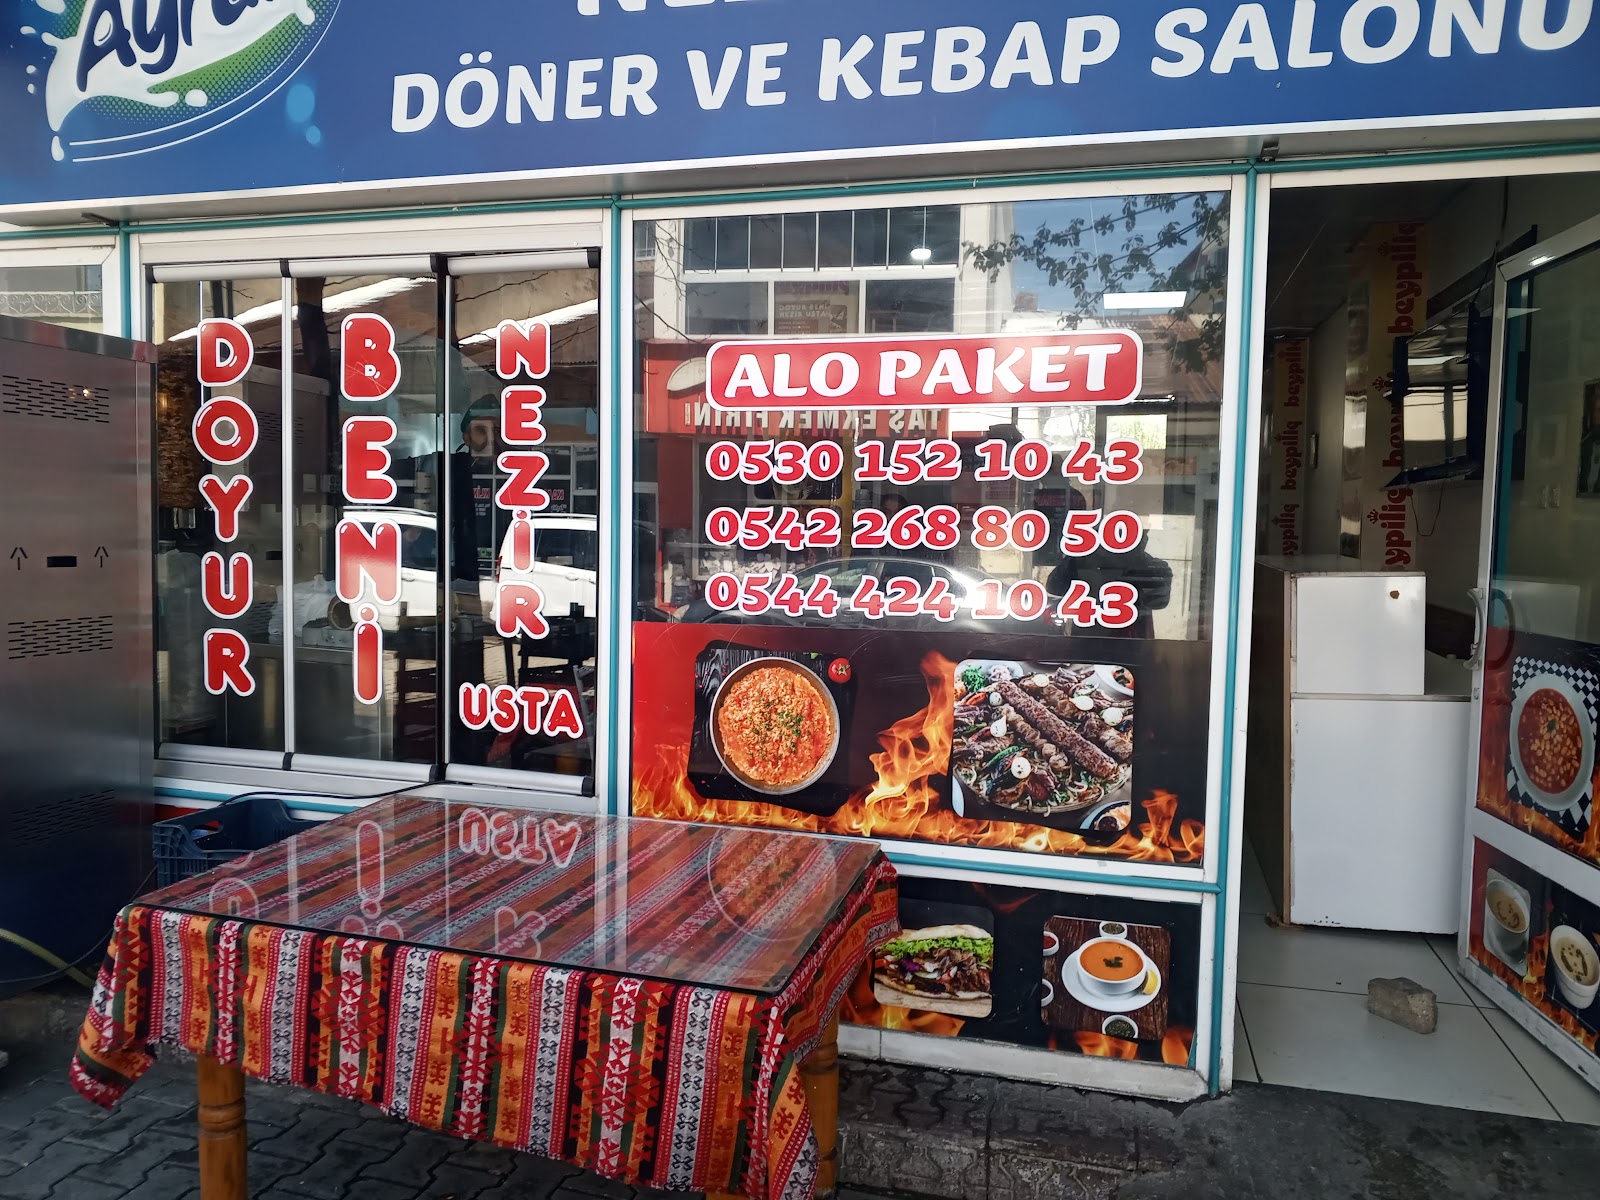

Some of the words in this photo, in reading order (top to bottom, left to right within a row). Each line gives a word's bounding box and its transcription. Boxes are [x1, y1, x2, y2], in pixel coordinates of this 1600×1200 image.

[391, 52, 658, 134] DÖNER
[686, 42, 788, 110] VE
[818, 14, 1121, 101] KEBAP
[1150, 0, 1592, 79] SALONU
[725, 351, 860, 398] ALO
[877, 343, 1122, 397] PAKET
[495, 319, 550, 640] NEZİR
[705, 439, 843, 485] 0530
[856, 439, 960, 485] 152
[975, 438, 1052, 482] 10
[1062, 439, 1143, 485] 43
[192, 317, 258, 697] DOYUR
[335, 313, 401, 704] BENİ
[705, 505, 841, 550] 0542
[851, 505, 960, 551] 268
[972, 506, 1050, 553] 80
[1061, 508, 1144, 557] 50
[705, 572, 840, 616] 0544
[850, 573, 959, 621] 424
[970, 578, 1047, 621] 10
[1057, 579, 1138, 629] 43
[459, 682, 584, 740] USTA
